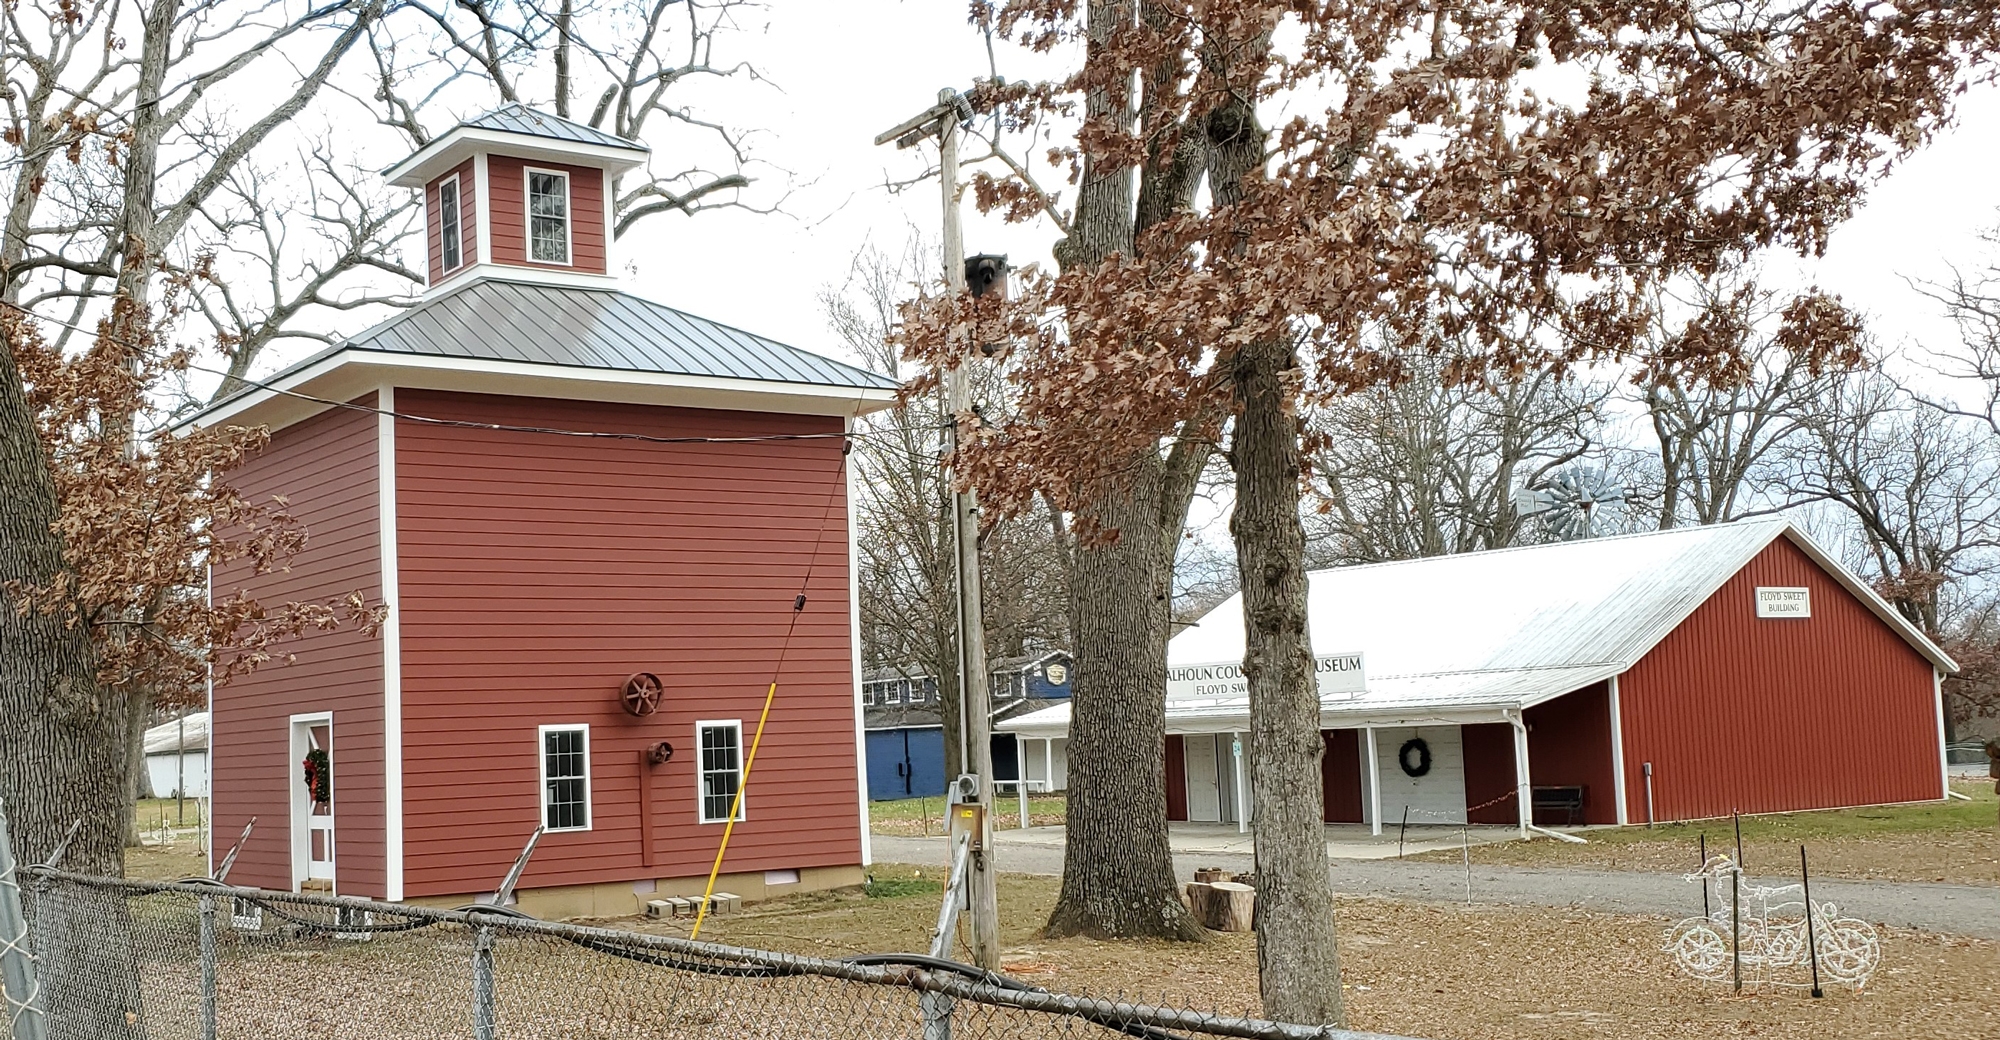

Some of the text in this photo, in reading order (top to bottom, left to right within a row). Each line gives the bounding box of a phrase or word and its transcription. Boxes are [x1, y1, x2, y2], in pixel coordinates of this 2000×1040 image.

[1760, 592, 1805, 601] FLOYD SWEET
[1768, 603, 1800, 612] BUILDING
[1167, 657, 1362, 682] ALHOUN COU USEUM
[1196, 684, 1228, 695] FLOYD
